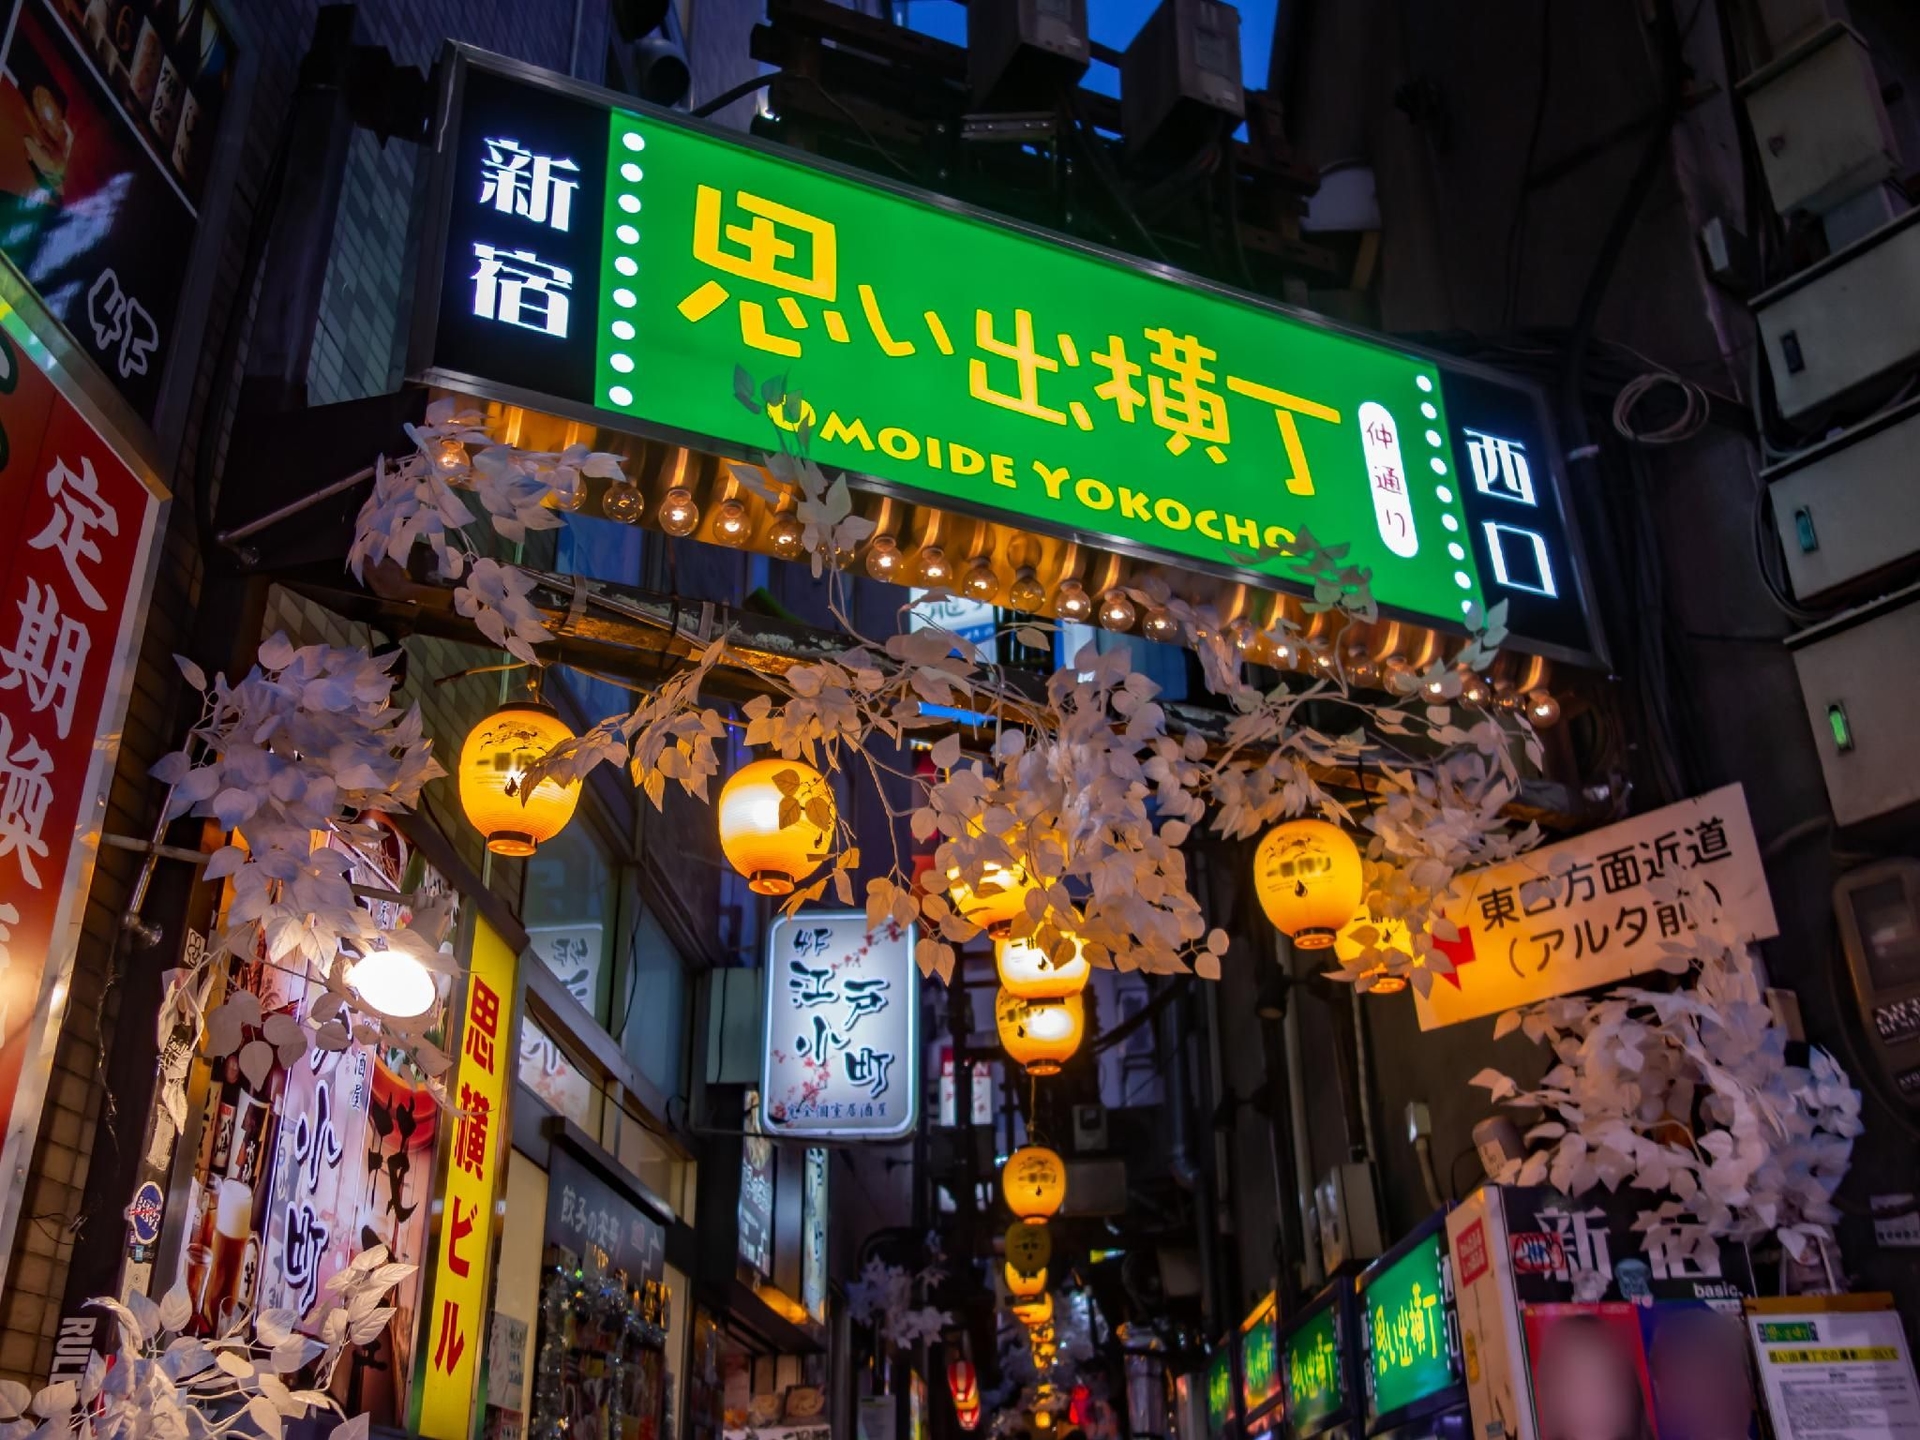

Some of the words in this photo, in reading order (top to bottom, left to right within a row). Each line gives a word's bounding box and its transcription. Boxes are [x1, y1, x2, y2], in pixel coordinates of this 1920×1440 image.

[471, 136, 580, 339] 新宿
[676, 184, 1341, 496] 思い出横丁
[766, 394, 1018, 488] OMOIDE
[1033, 459, 1298, 557] YOKOCHO
[1366, 420, 1406, 538] 仲通り
[1463, 427, 1557, 598] 西口
[0, 455, 119, 968] 定期換
[793, 927, 831, 957] 4F
[1476, 816, 1733, 932] 東口方面近道
[433, 974, 500, 1376] 思横ビル
[786, 1101, 888, 1120] 完全個室居酒屋
